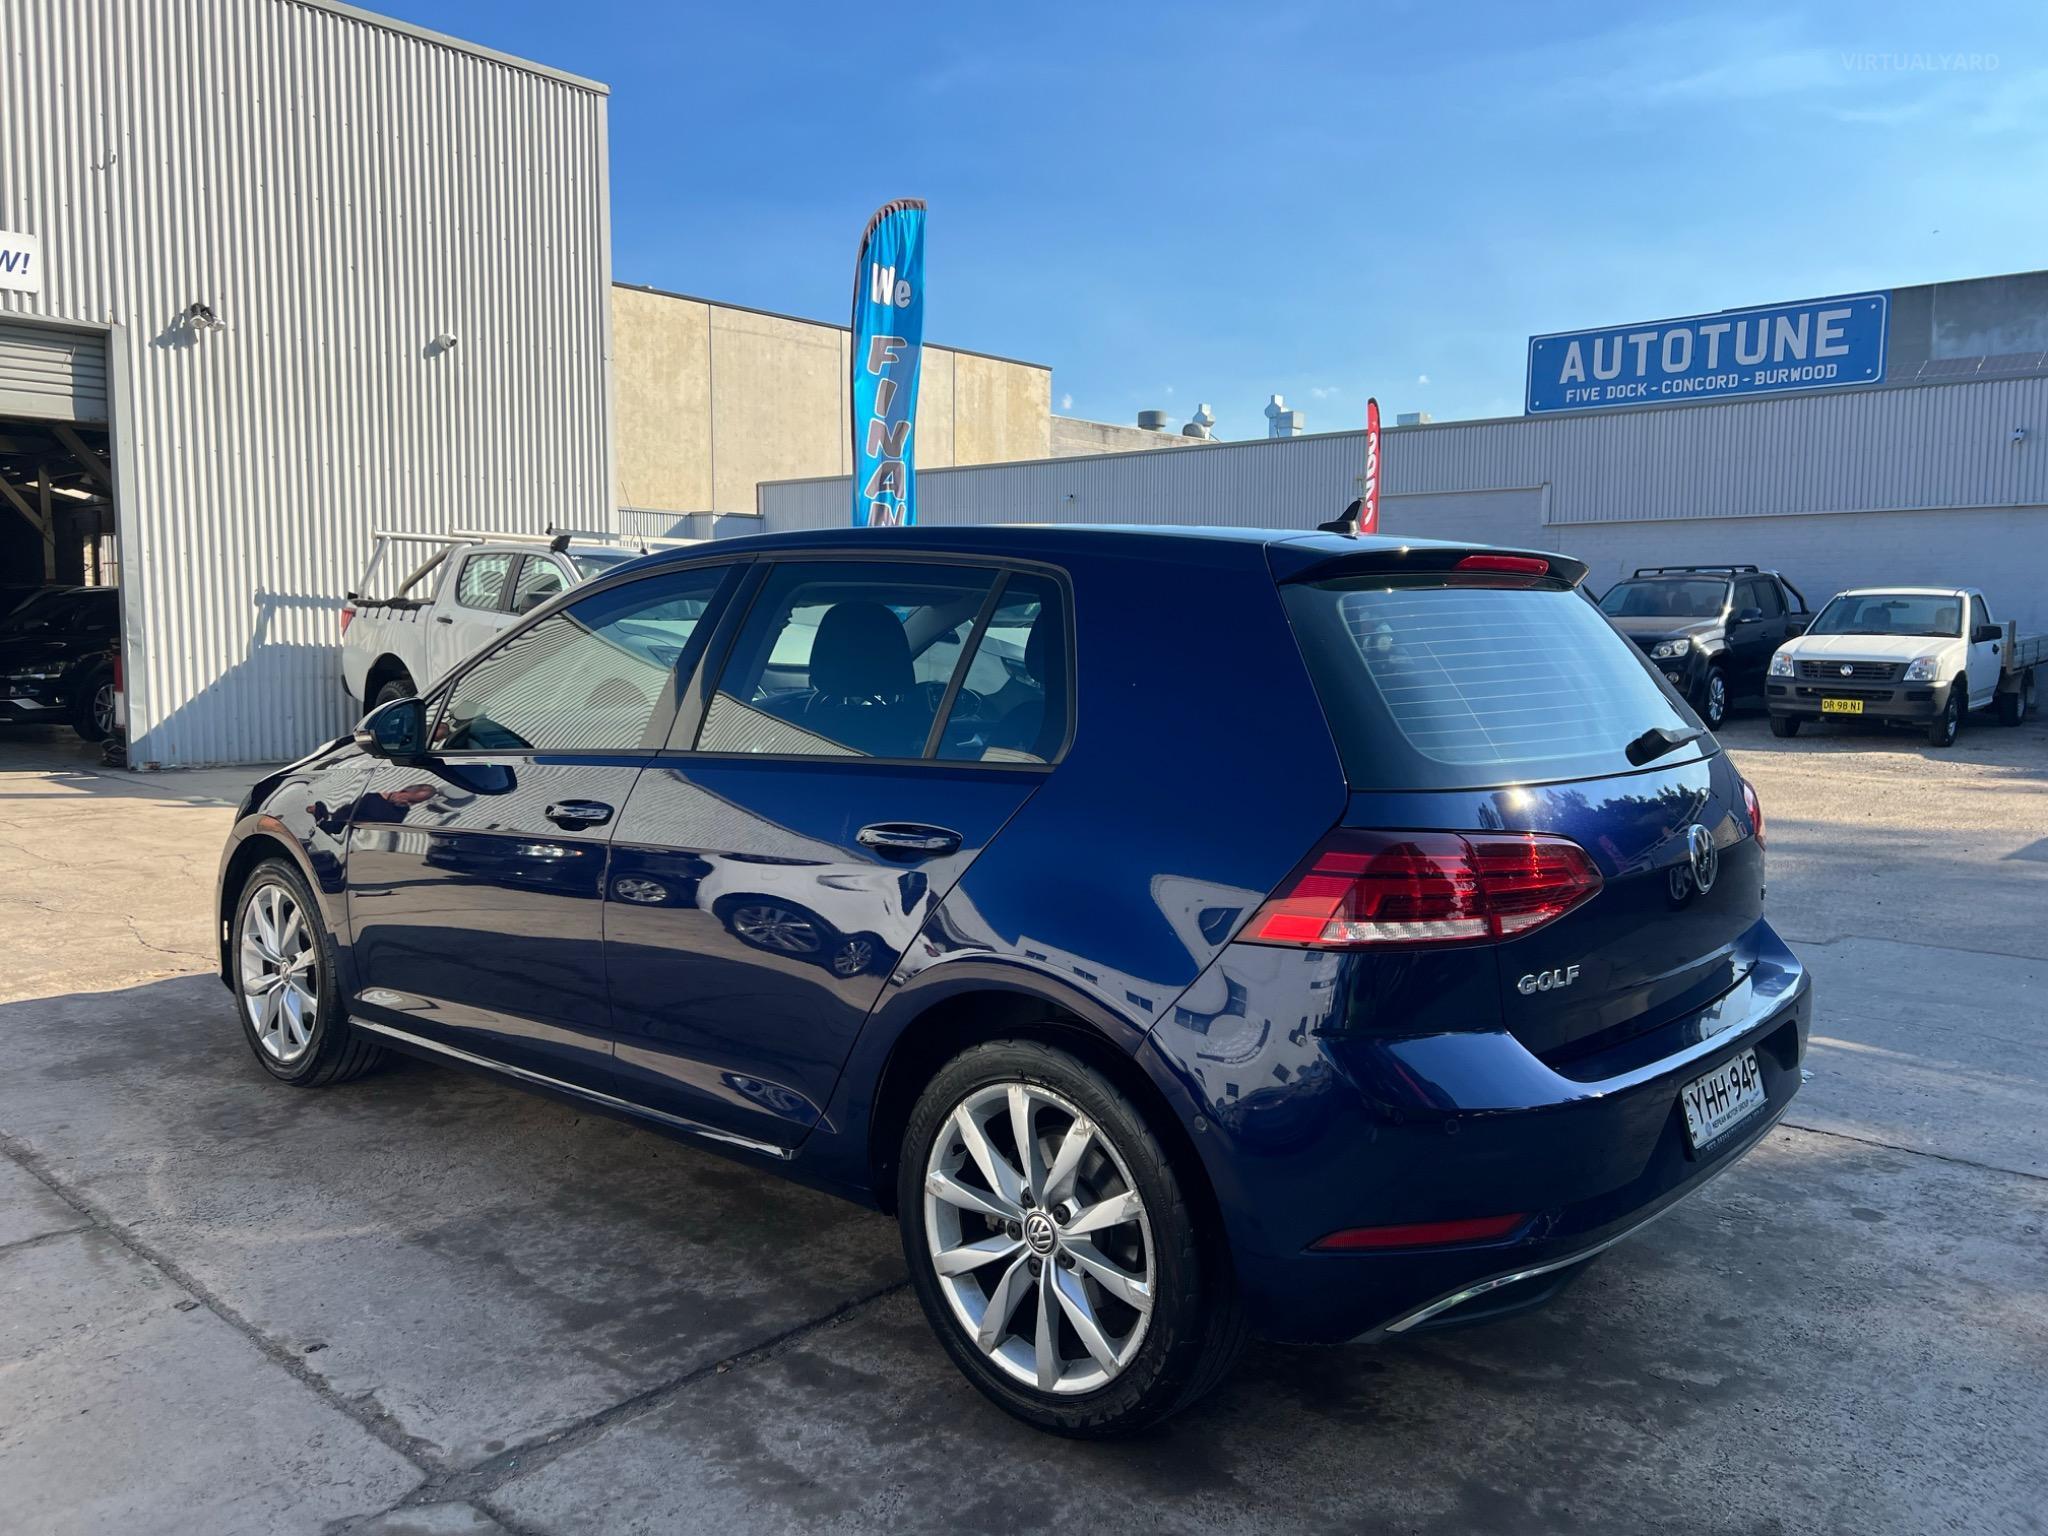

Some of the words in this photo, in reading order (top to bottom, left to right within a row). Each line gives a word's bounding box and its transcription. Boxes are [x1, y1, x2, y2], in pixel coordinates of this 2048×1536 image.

[872, 262, 912, 308] We
[1558, 308, 1852, 385] AUTOTUNE
[1566, 387, 1601, 403] FIVE
[1754, 363, 1838, 386] BURWOOD
[1517, 964, 1581, 995] GOLF
